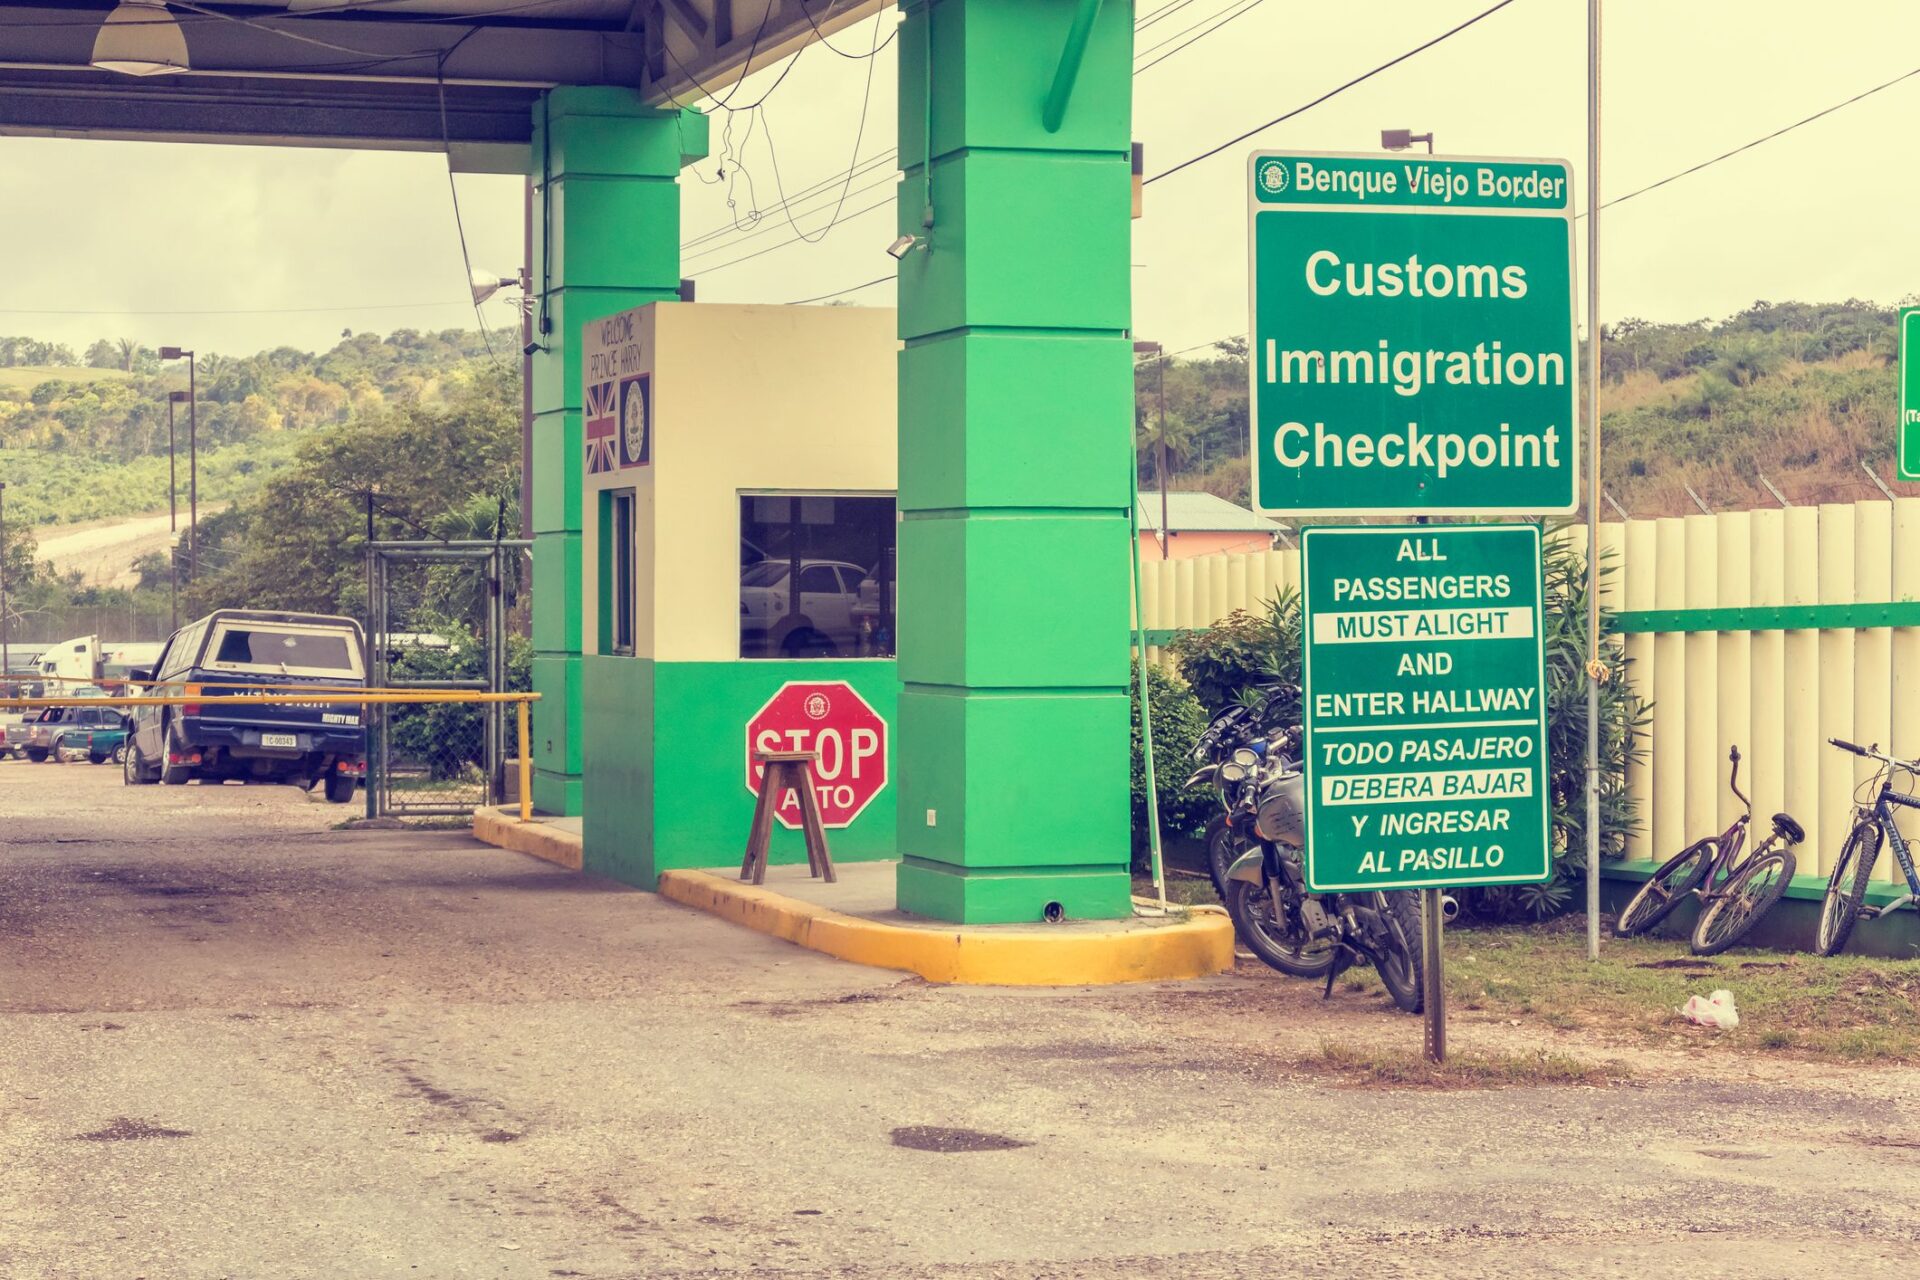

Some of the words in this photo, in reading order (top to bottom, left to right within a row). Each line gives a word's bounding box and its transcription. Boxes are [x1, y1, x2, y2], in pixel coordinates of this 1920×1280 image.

[1296, 162, 1397, 200] Benque
[1405, 165, 1469, 203] Viejo
[1477, 168, 1565, 199] Border
[1306, 251, 1527, 299] Customs
[602, 312, 633, 347] WELCOME
[590, 350, 617, 382] PRINCE
[620, 343, 642, 375] HARRY
[1266, 339, 1564, 396] Immigration
[1274, 422, 1560, 478] Checkpoint
[1396, 538, 1447, 562] ALL
[1334, 575, 1511, 602] PASSENGERS
[1337, 614, 1409, 638] MUST
[1415, 611, 1509, 636] ALIGHT
[1397, 652, 1453, 676] AND
[1316, 692, 1405, 717] ENTER
[1413, 687, 1535, 714] HALLWAY
[1322, 741, 1393, 766] TODO
[1400, 736, 1533, 763] PASAJERO
[781, 785, 855, 811] ATO
[1330, 777, 1434, 801] DEBERA
[1442, 772, 1527, 796] BAJAR
[1352, 815, 1369, 837] Y
[1380, 808, 1510, 836] INGRESAR
[1357, 851, 1392, 874] AL
[1398, 844, 1504, 872] PASILLO
